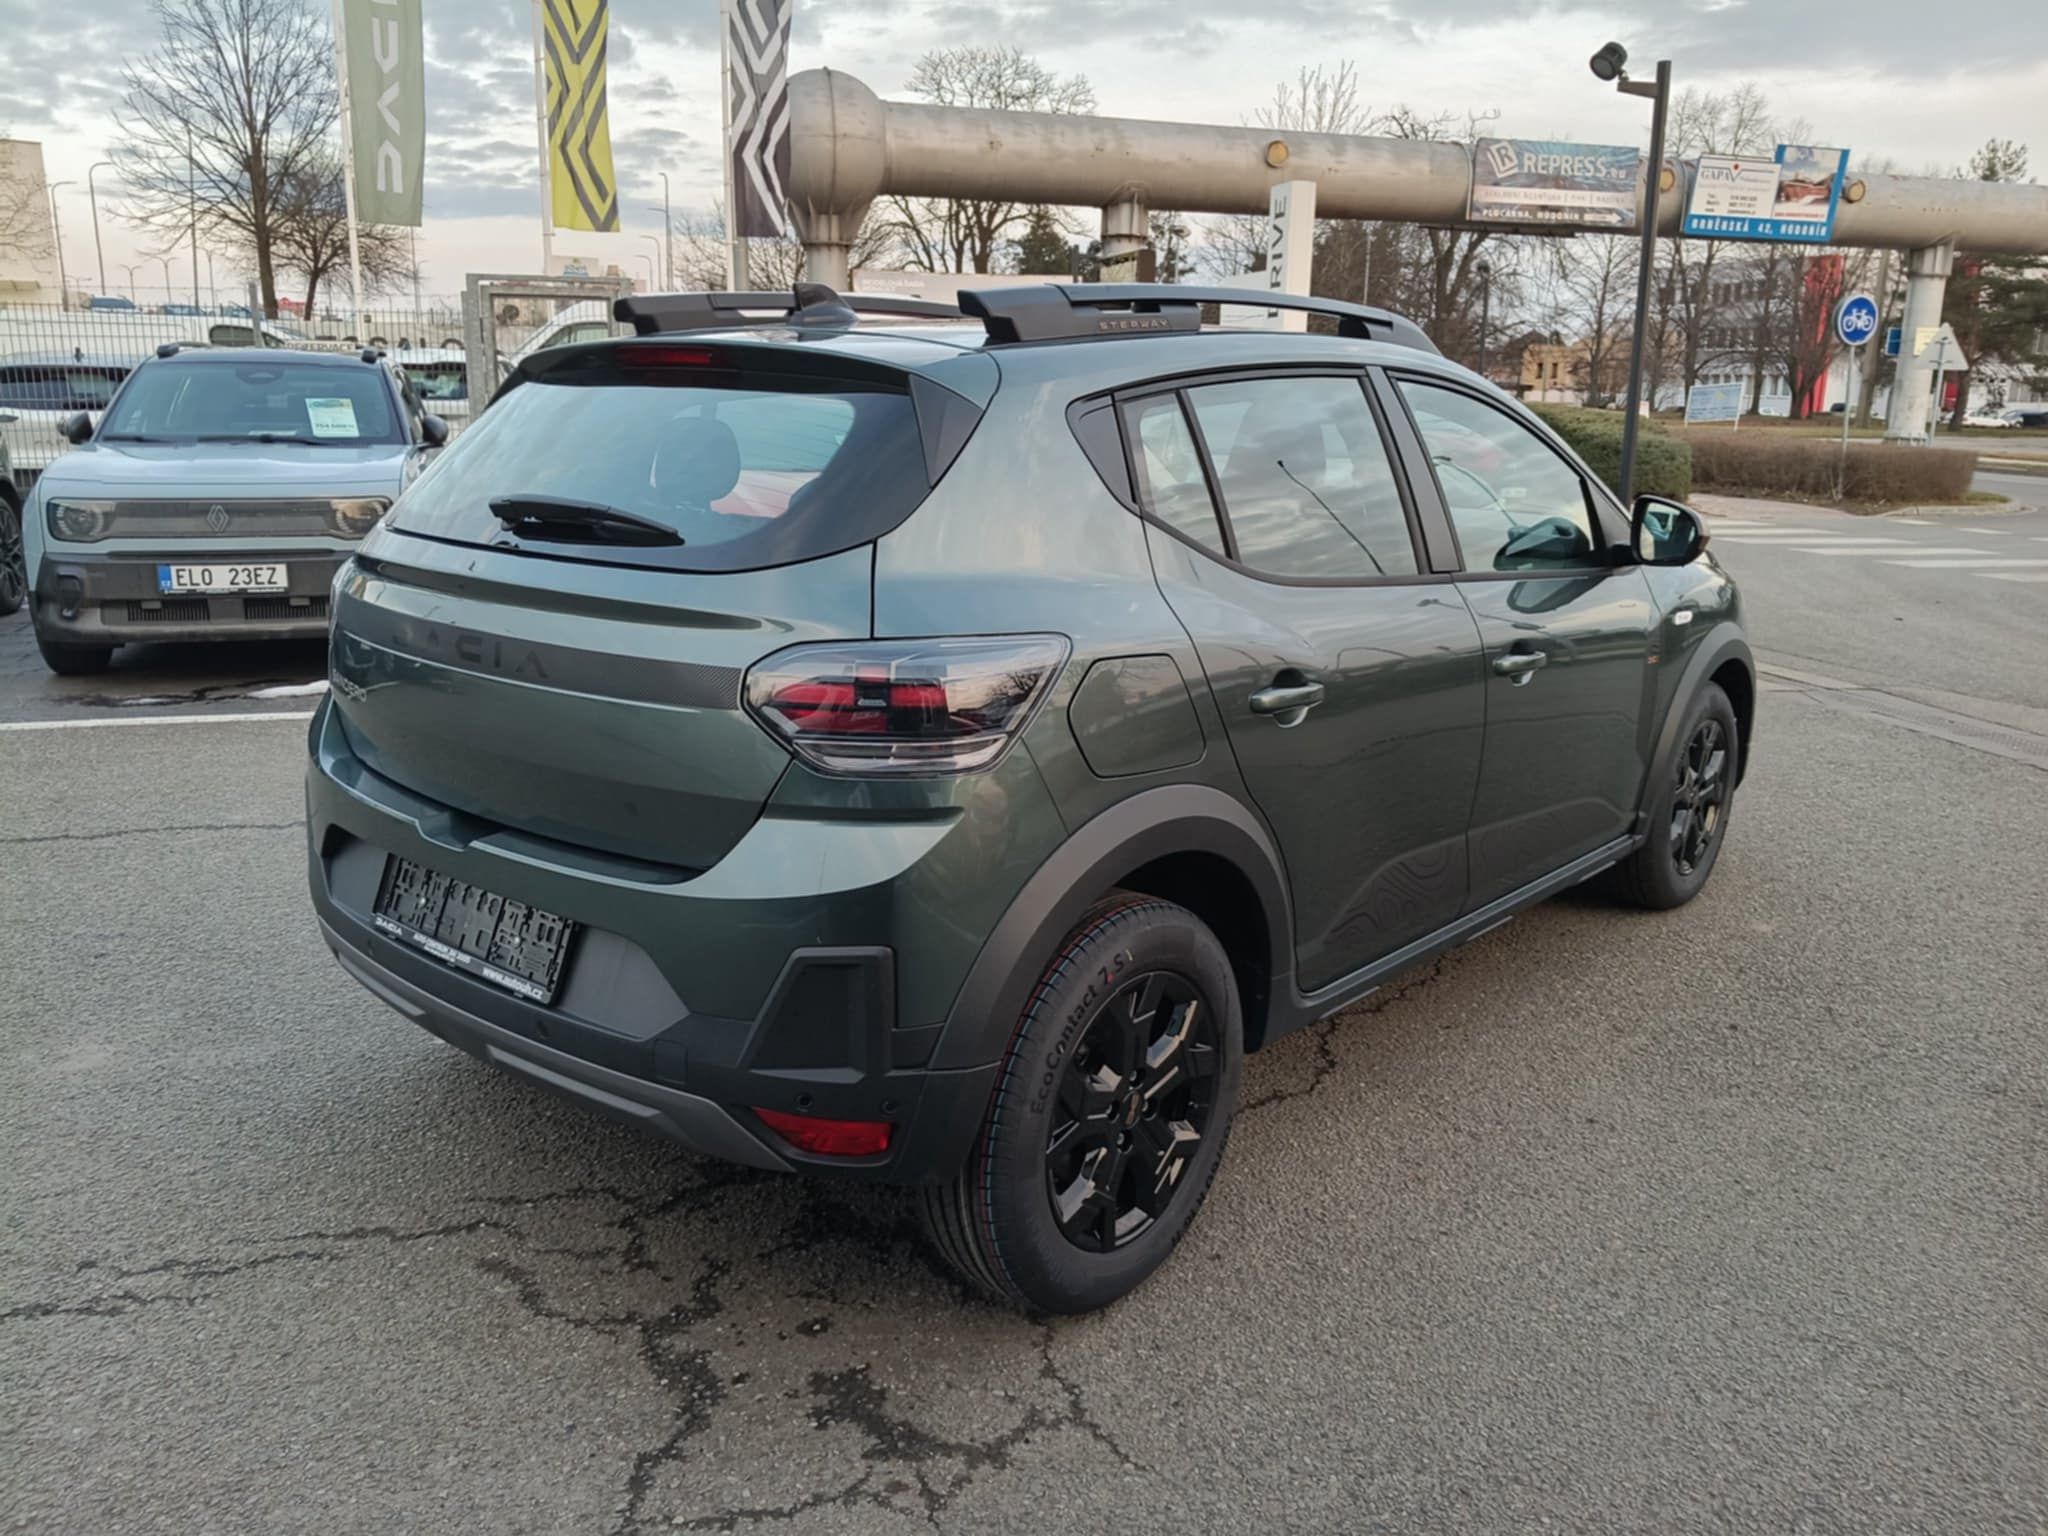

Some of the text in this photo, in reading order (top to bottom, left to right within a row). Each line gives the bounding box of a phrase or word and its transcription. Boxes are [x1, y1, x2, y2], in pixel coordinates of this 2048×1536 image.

[1522, 152, 1627, 179] REPRESS.eu
[228, 567, 278, 586] 23EZ
[375, 916, 403, 936] DACIA
[1031, 985, 1099, 1115] EcoContact
